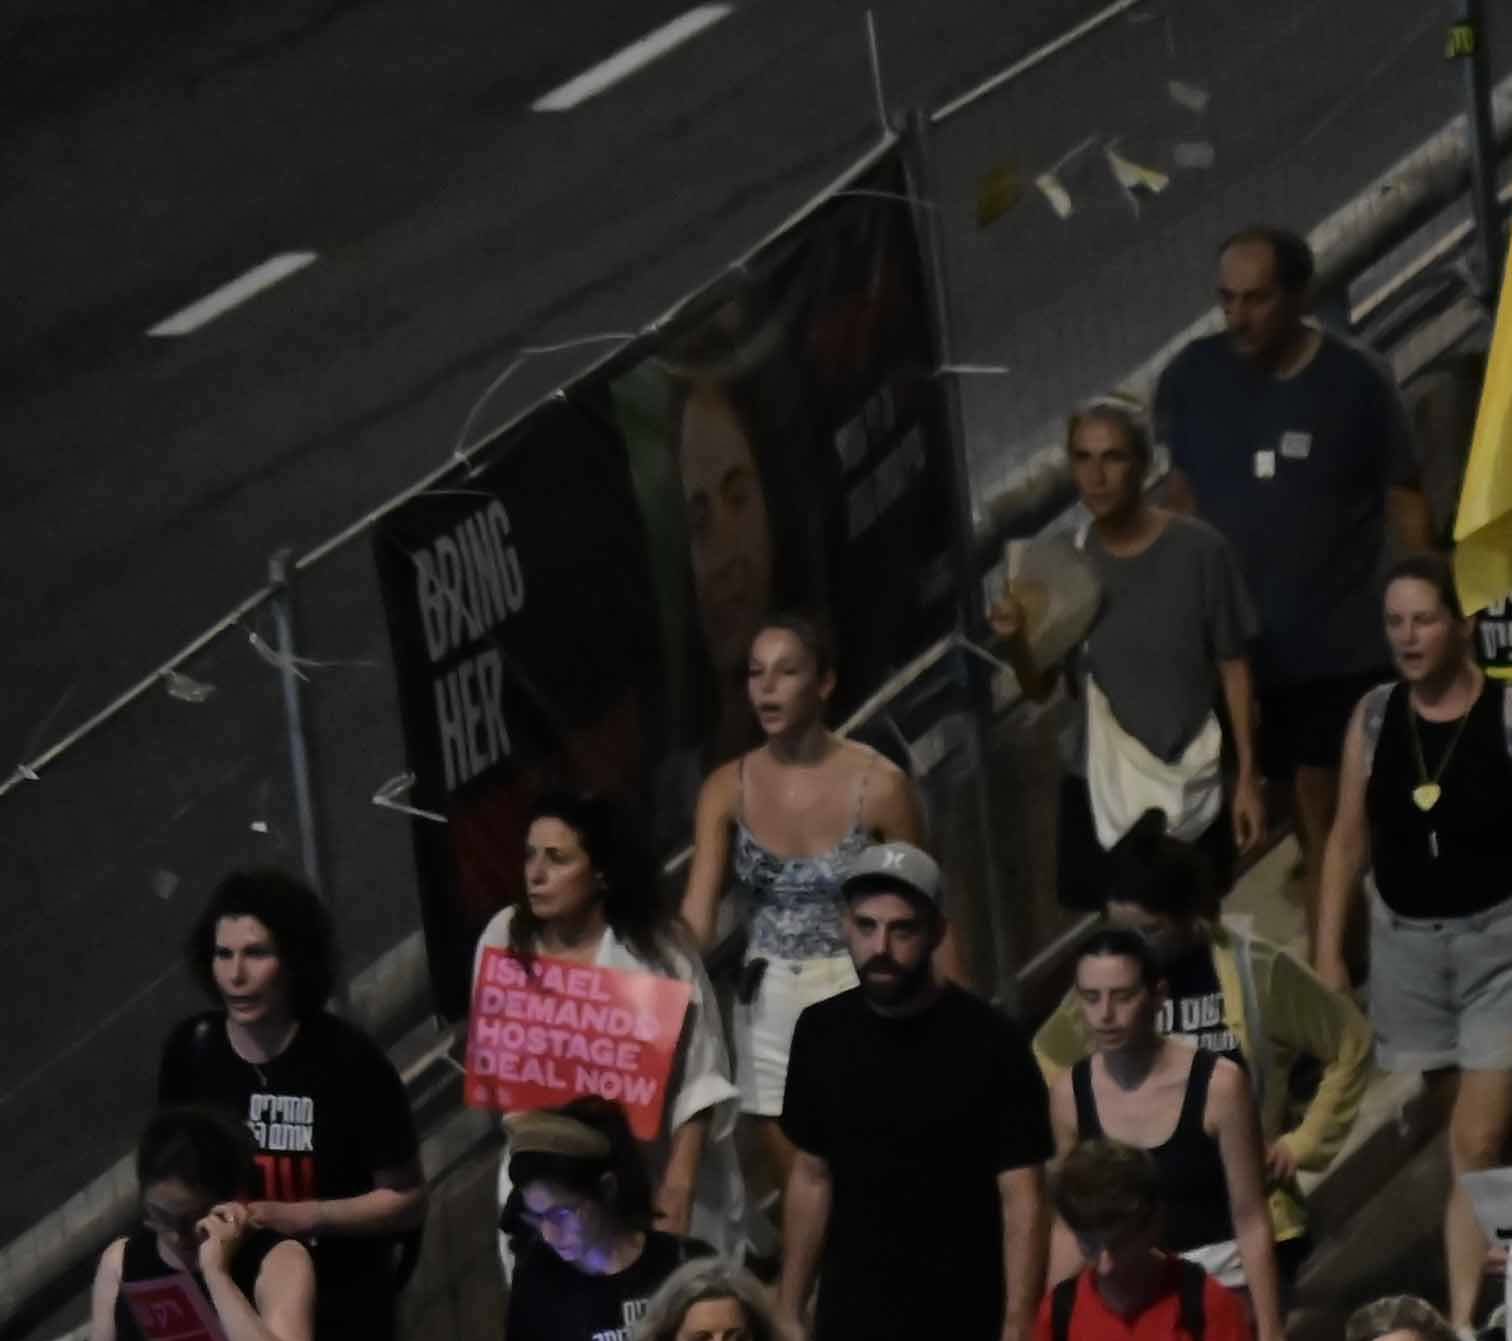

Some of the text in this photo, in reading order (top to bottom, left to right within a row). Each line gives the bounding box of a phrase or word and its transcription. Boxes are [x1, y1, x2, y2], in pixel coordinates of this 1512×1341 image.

[410, 500, 525, 660] BRING
[432, 655, 515, 792] HER
[480, 988, 660, 1042] DEMANDS
[476, 1020, 641, 1071] HOSTAGE
[475, 1049, 657, 1106] DEAL NOW
